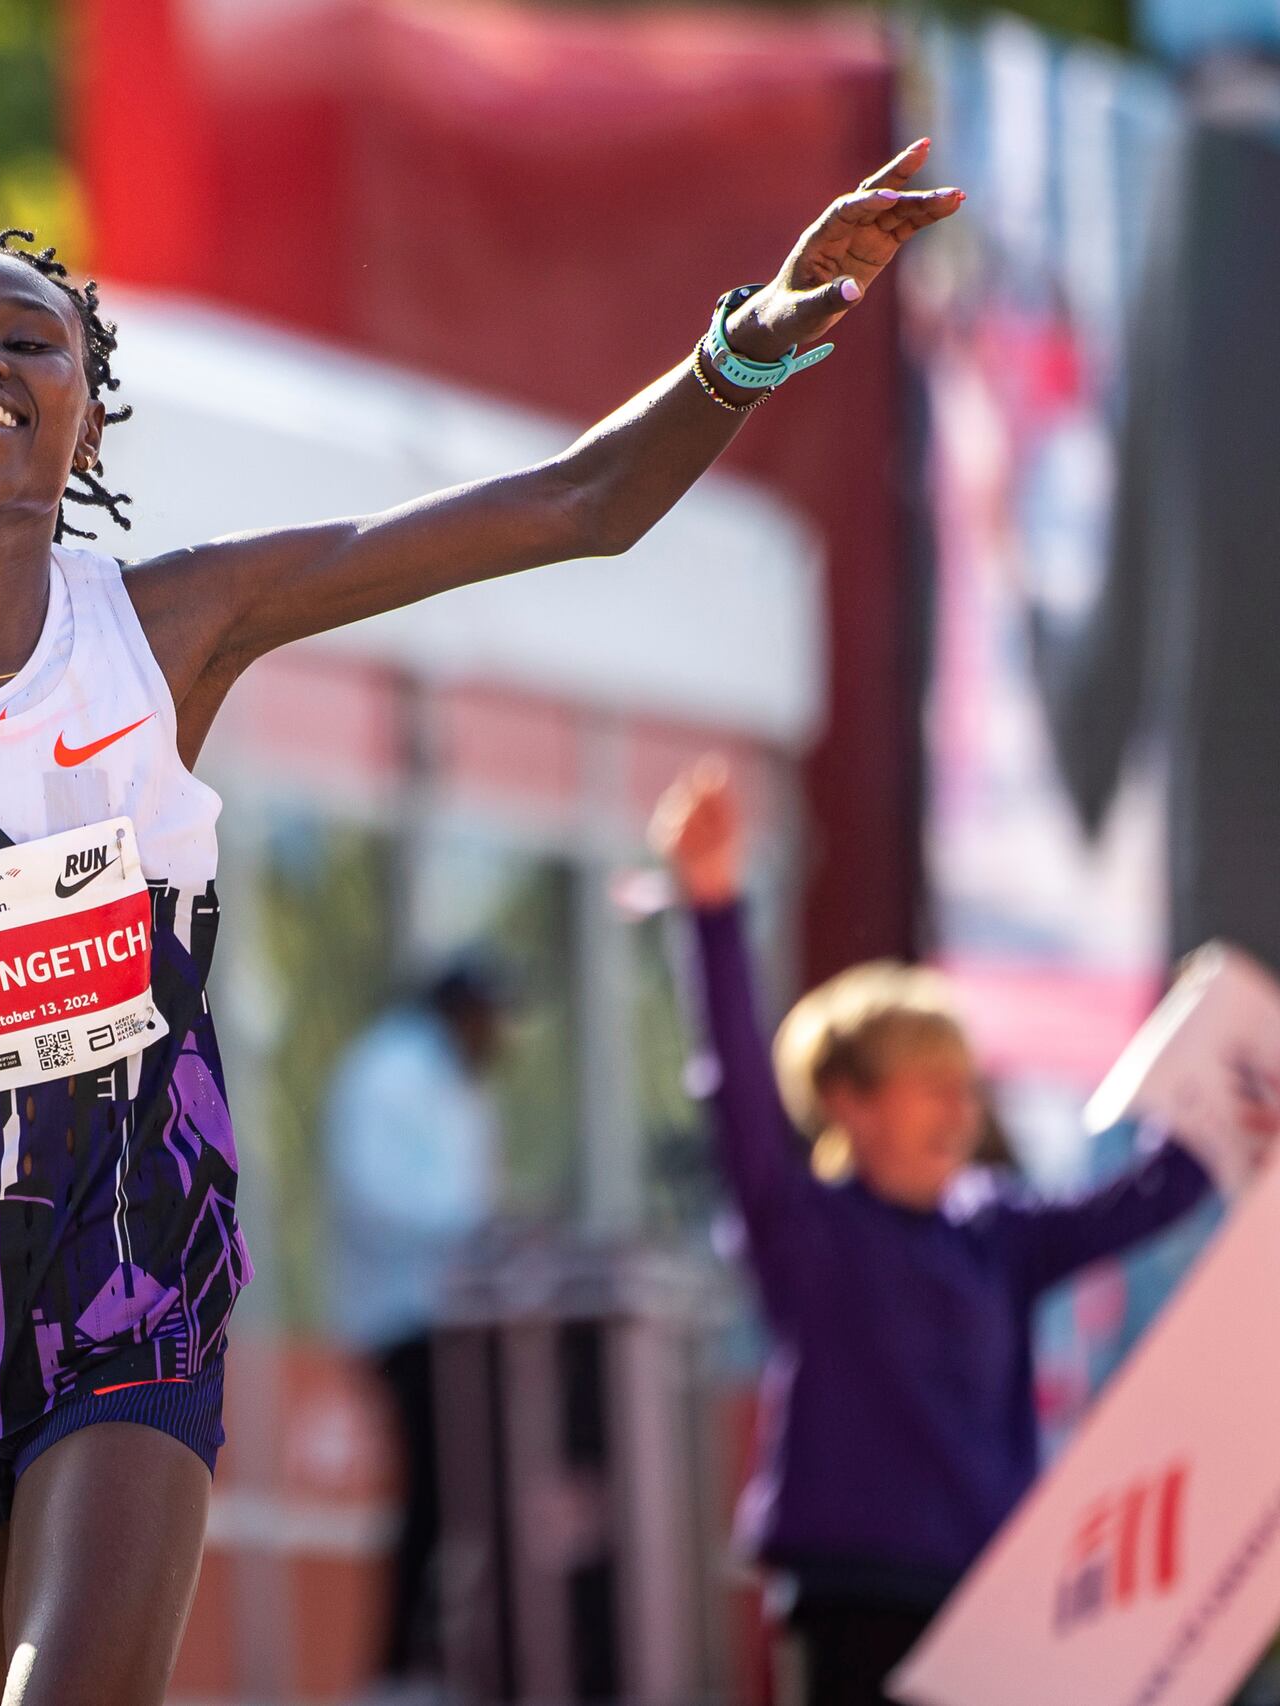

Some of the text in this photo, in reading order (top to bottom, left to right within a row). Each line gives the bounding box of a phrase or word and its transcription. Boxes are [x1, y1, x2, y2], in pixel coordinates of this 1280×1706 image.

[65, 845, 107, 878] RUN
[39, 1003, 61, 1017] 13,
[65, 992, 99, 1011] 2024
